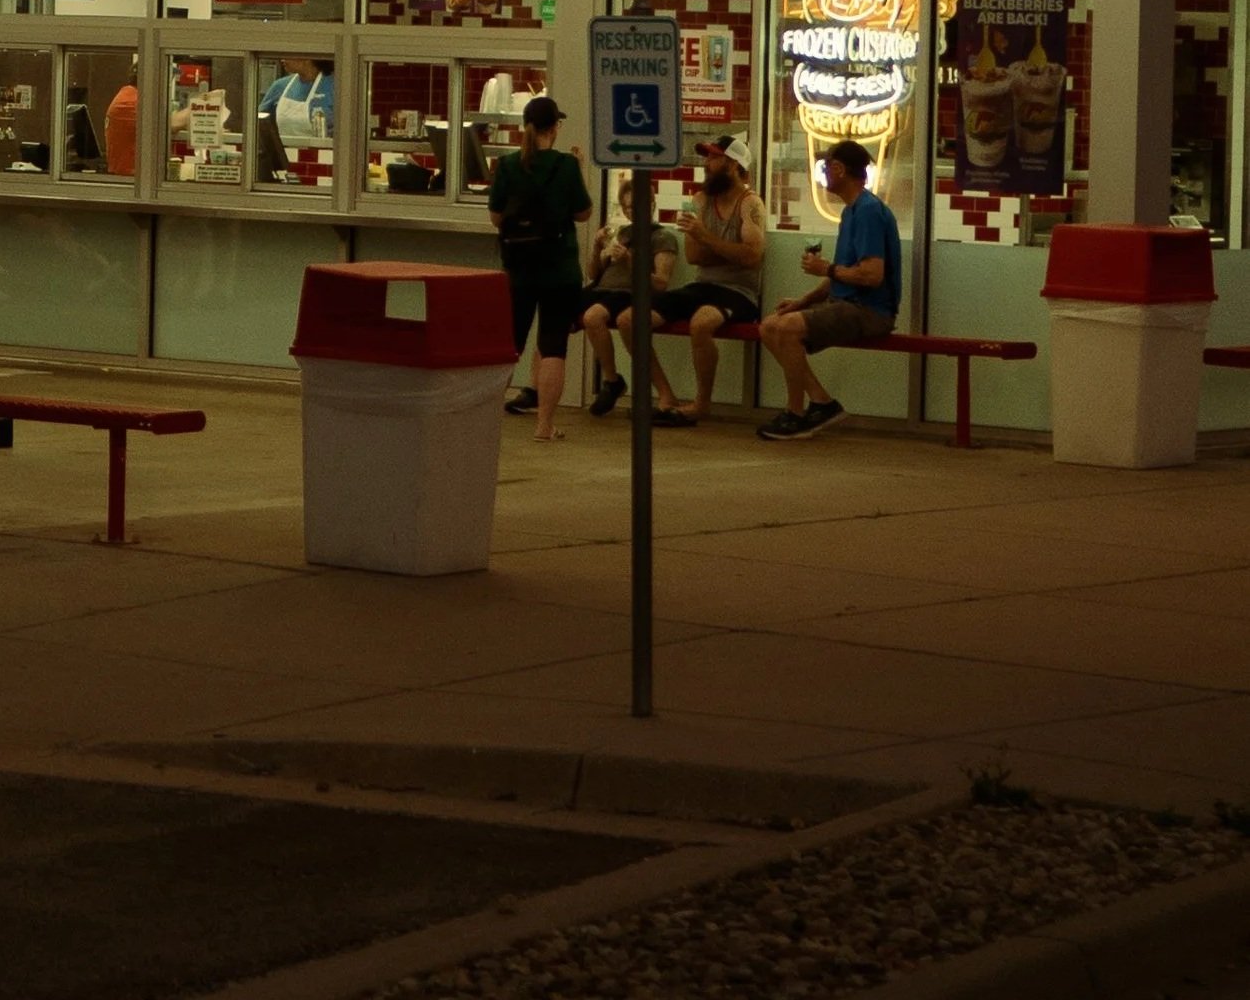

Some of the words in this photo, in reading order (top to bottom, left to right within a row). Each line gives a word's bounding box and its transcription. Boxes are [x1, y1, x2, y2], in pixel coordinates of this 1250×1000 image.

[977, 12, 1004, 25] ARE
[1006, 13, 1048, 26] BACK!
[595, 32, 672, 51] RESERVED
[783, 27, 846, 61] FROZEN
[601, 57, 668, 77] PARKING
[799, 69, 847, 96] MADE
[846, 71, 897, 96] FRESH
[693, 104, 726, 116] POINTS
